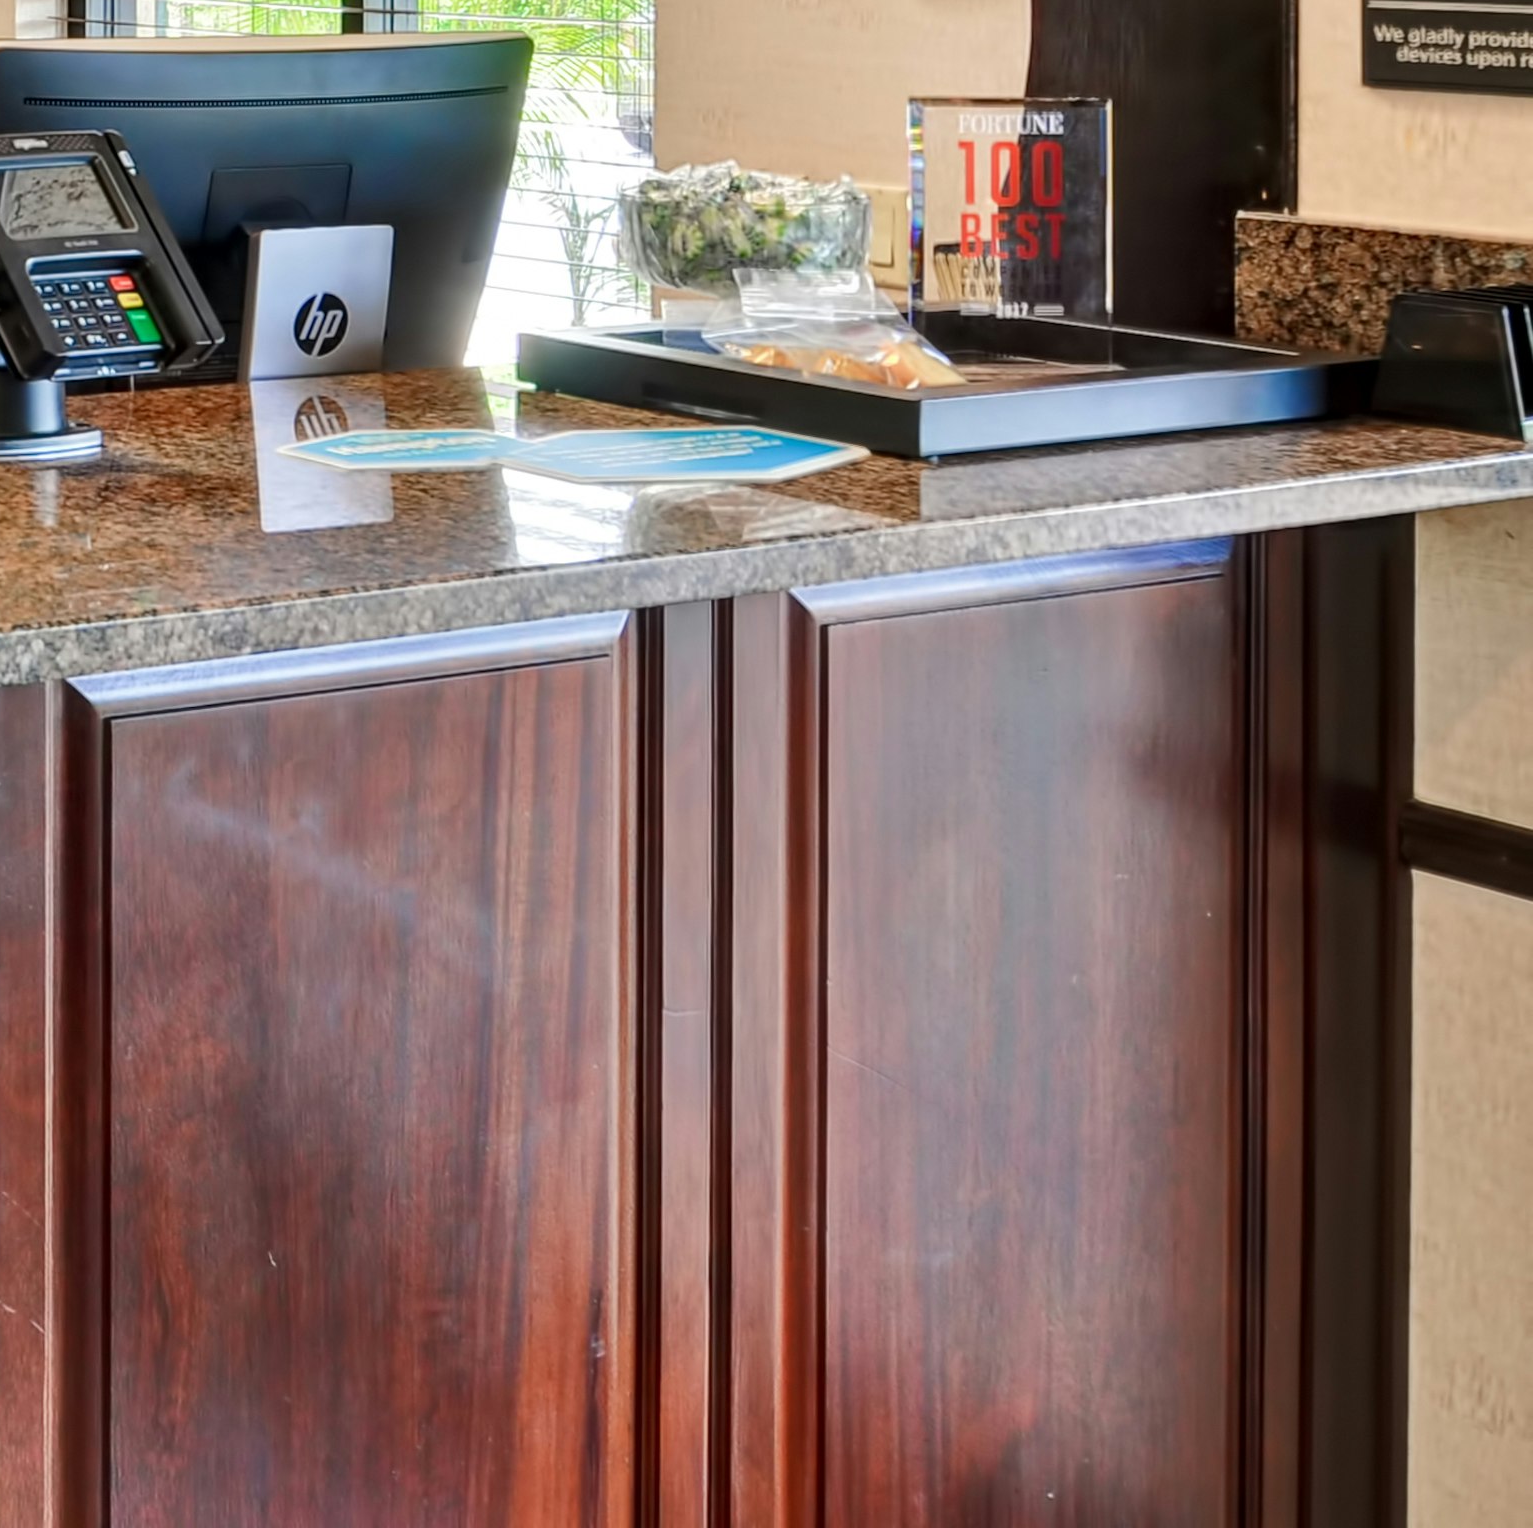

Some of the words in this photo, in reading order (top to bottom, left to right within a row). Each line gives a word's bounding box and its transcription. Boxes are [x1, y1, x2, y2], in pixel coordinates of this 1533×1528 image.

[1373, 24, 1405, 43] We
[1407, 25, 1465, 50] gladly
[1468, 30, 1533, 50] provid
[1396, 44, 1463, 66] devices
[1466, 49, 1517, 71] upon
[958, 113, 1065, 136] FORTUNE
[958, 139, 1064, 208] 100
[960, 212, 1066, 261] BEST
[299, 291, 344, 359] hp
